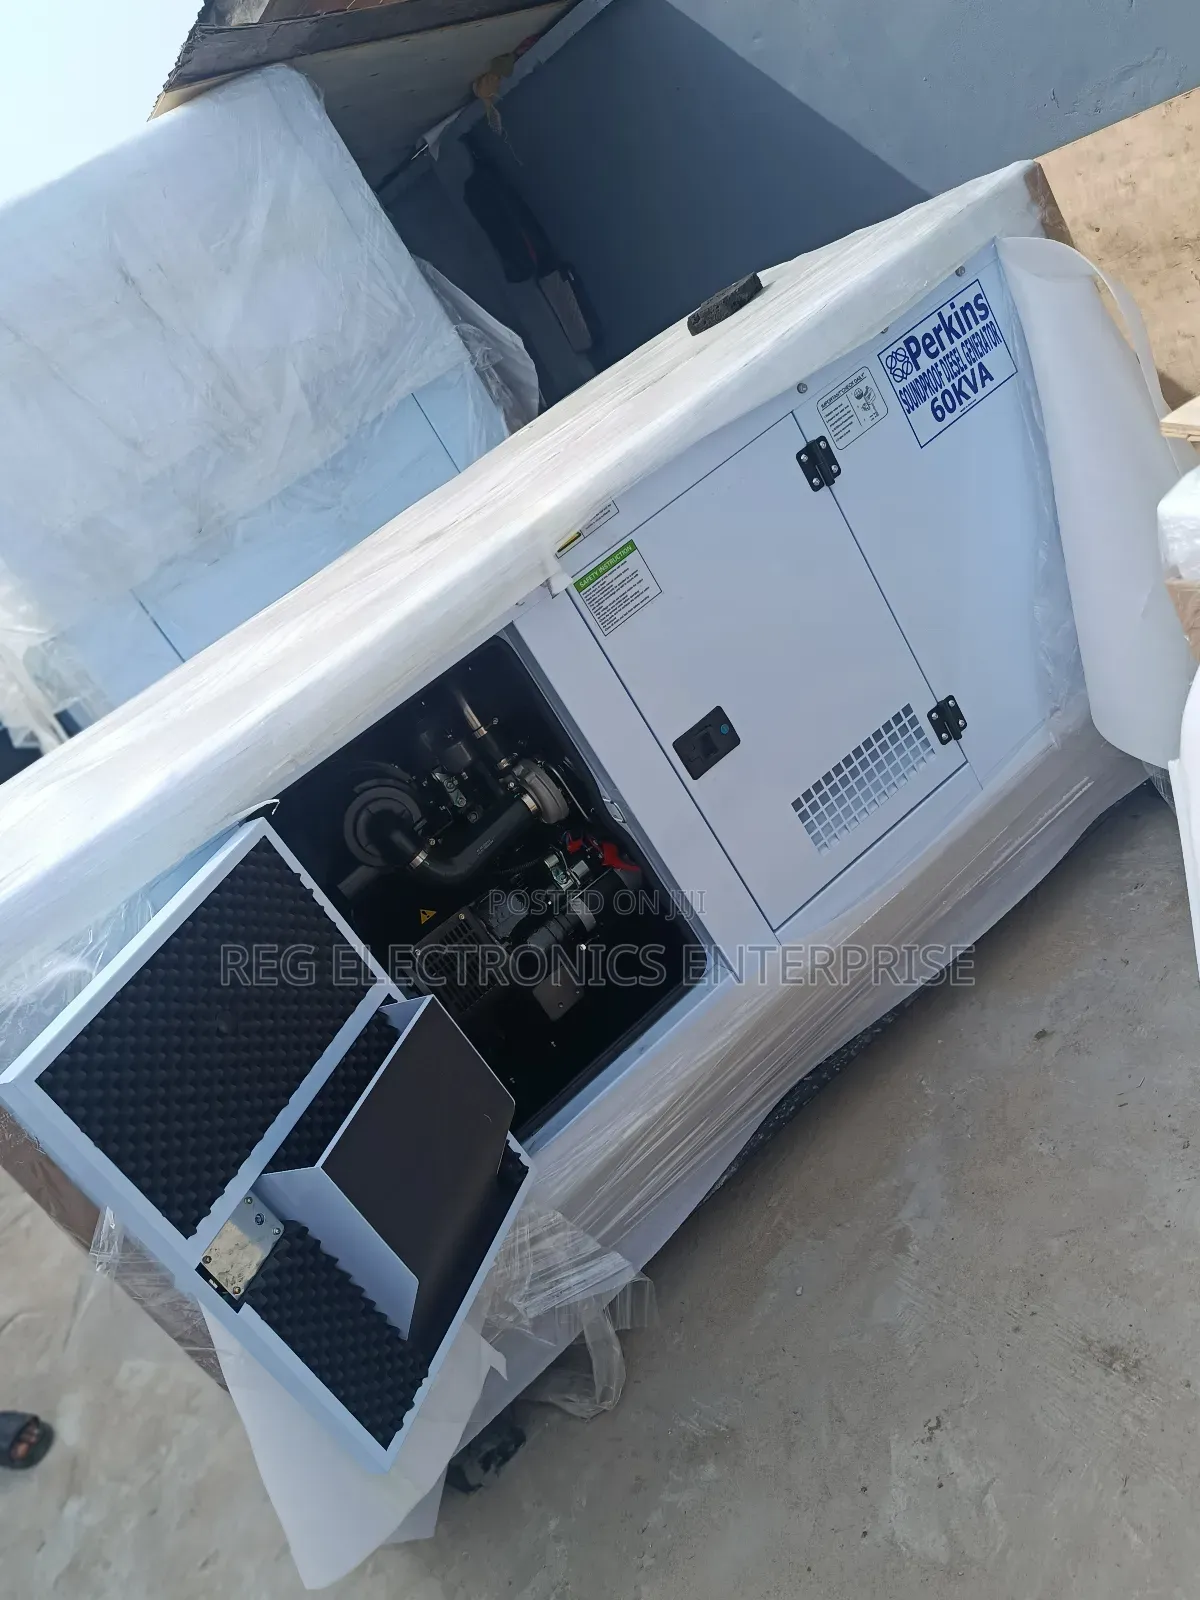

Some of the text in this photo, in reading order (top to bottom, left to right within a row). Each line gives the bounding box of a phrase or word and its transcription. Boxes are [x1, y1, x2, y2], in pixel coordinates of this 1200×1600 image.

[903, 293, 990, 371] Perkins
[899, 321, 1002, 414] SOUNDPROOF DIESEL GENERATOR
[930, 361, 994, 423] 60KVA
[579, 545, 632, 588] SAFETY INSTRUCTION
